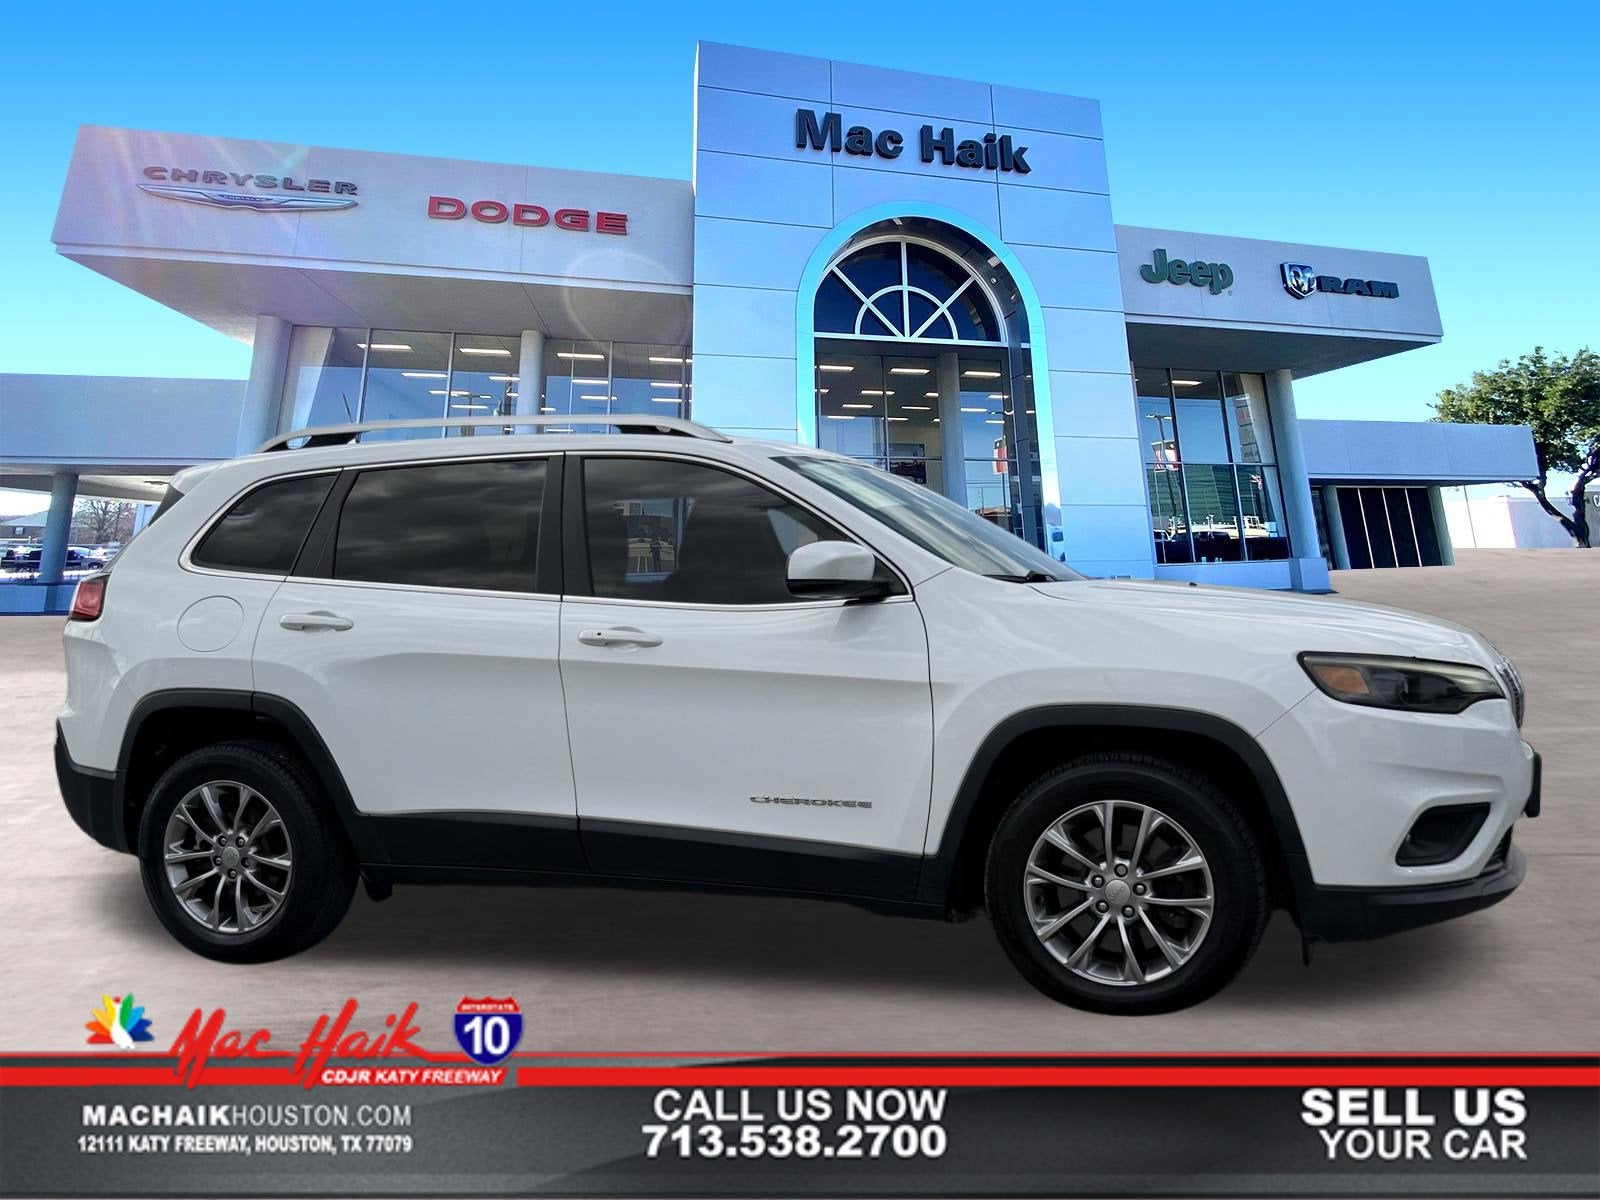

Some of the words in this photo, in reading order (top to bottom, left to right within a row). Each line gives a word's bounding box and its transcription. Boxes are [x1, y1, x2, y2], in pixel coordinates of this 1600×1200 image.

[796, 108, 904, 159] Mac
[920, 124, 1032, 174] Haik
[143, 166, 359, 196] CHRYSLER
[428, 195, 628, 236] DODGE
[1139, 248, 1234, 295] Jeep
[1316, 275, 1400, 299] RAM
[750, 796, 872, 809] CHEROKEE
